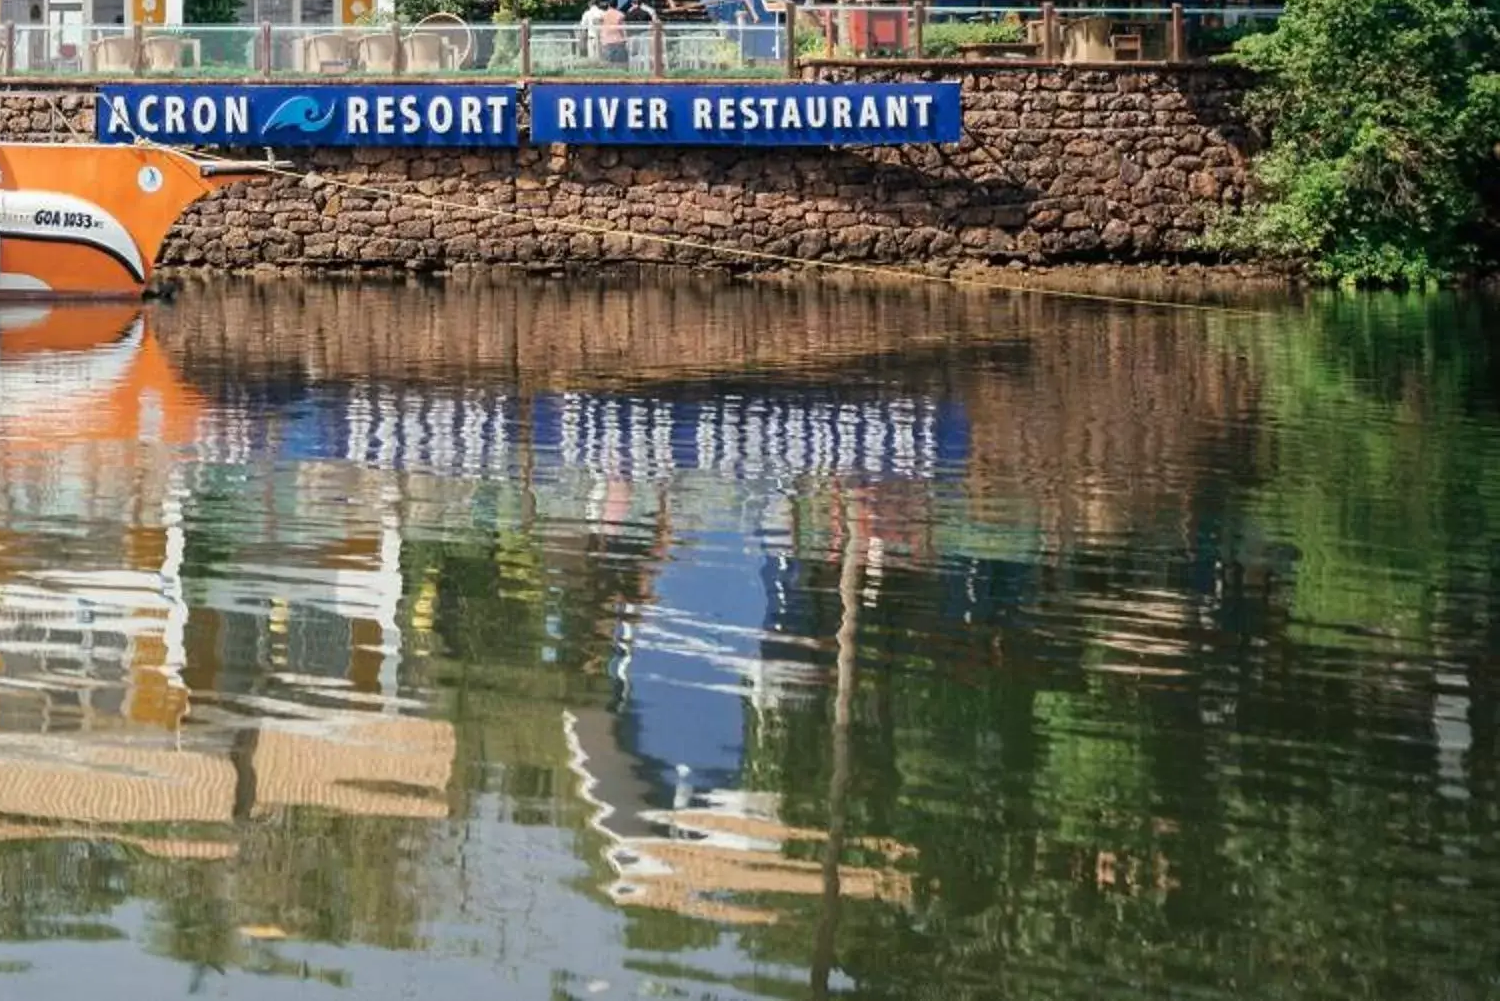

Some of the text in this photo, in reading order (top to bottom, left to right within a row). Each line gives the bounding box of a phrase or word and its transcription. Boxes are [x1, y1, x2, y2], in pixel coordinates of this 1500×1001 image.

[107, 95, 508, 135] ACRON RESORT
[558, 95, 934, 130] RIVER RESTAURANT
[34, 209, 61, 227] GOA
[64, 212, 92, 229] 1033
